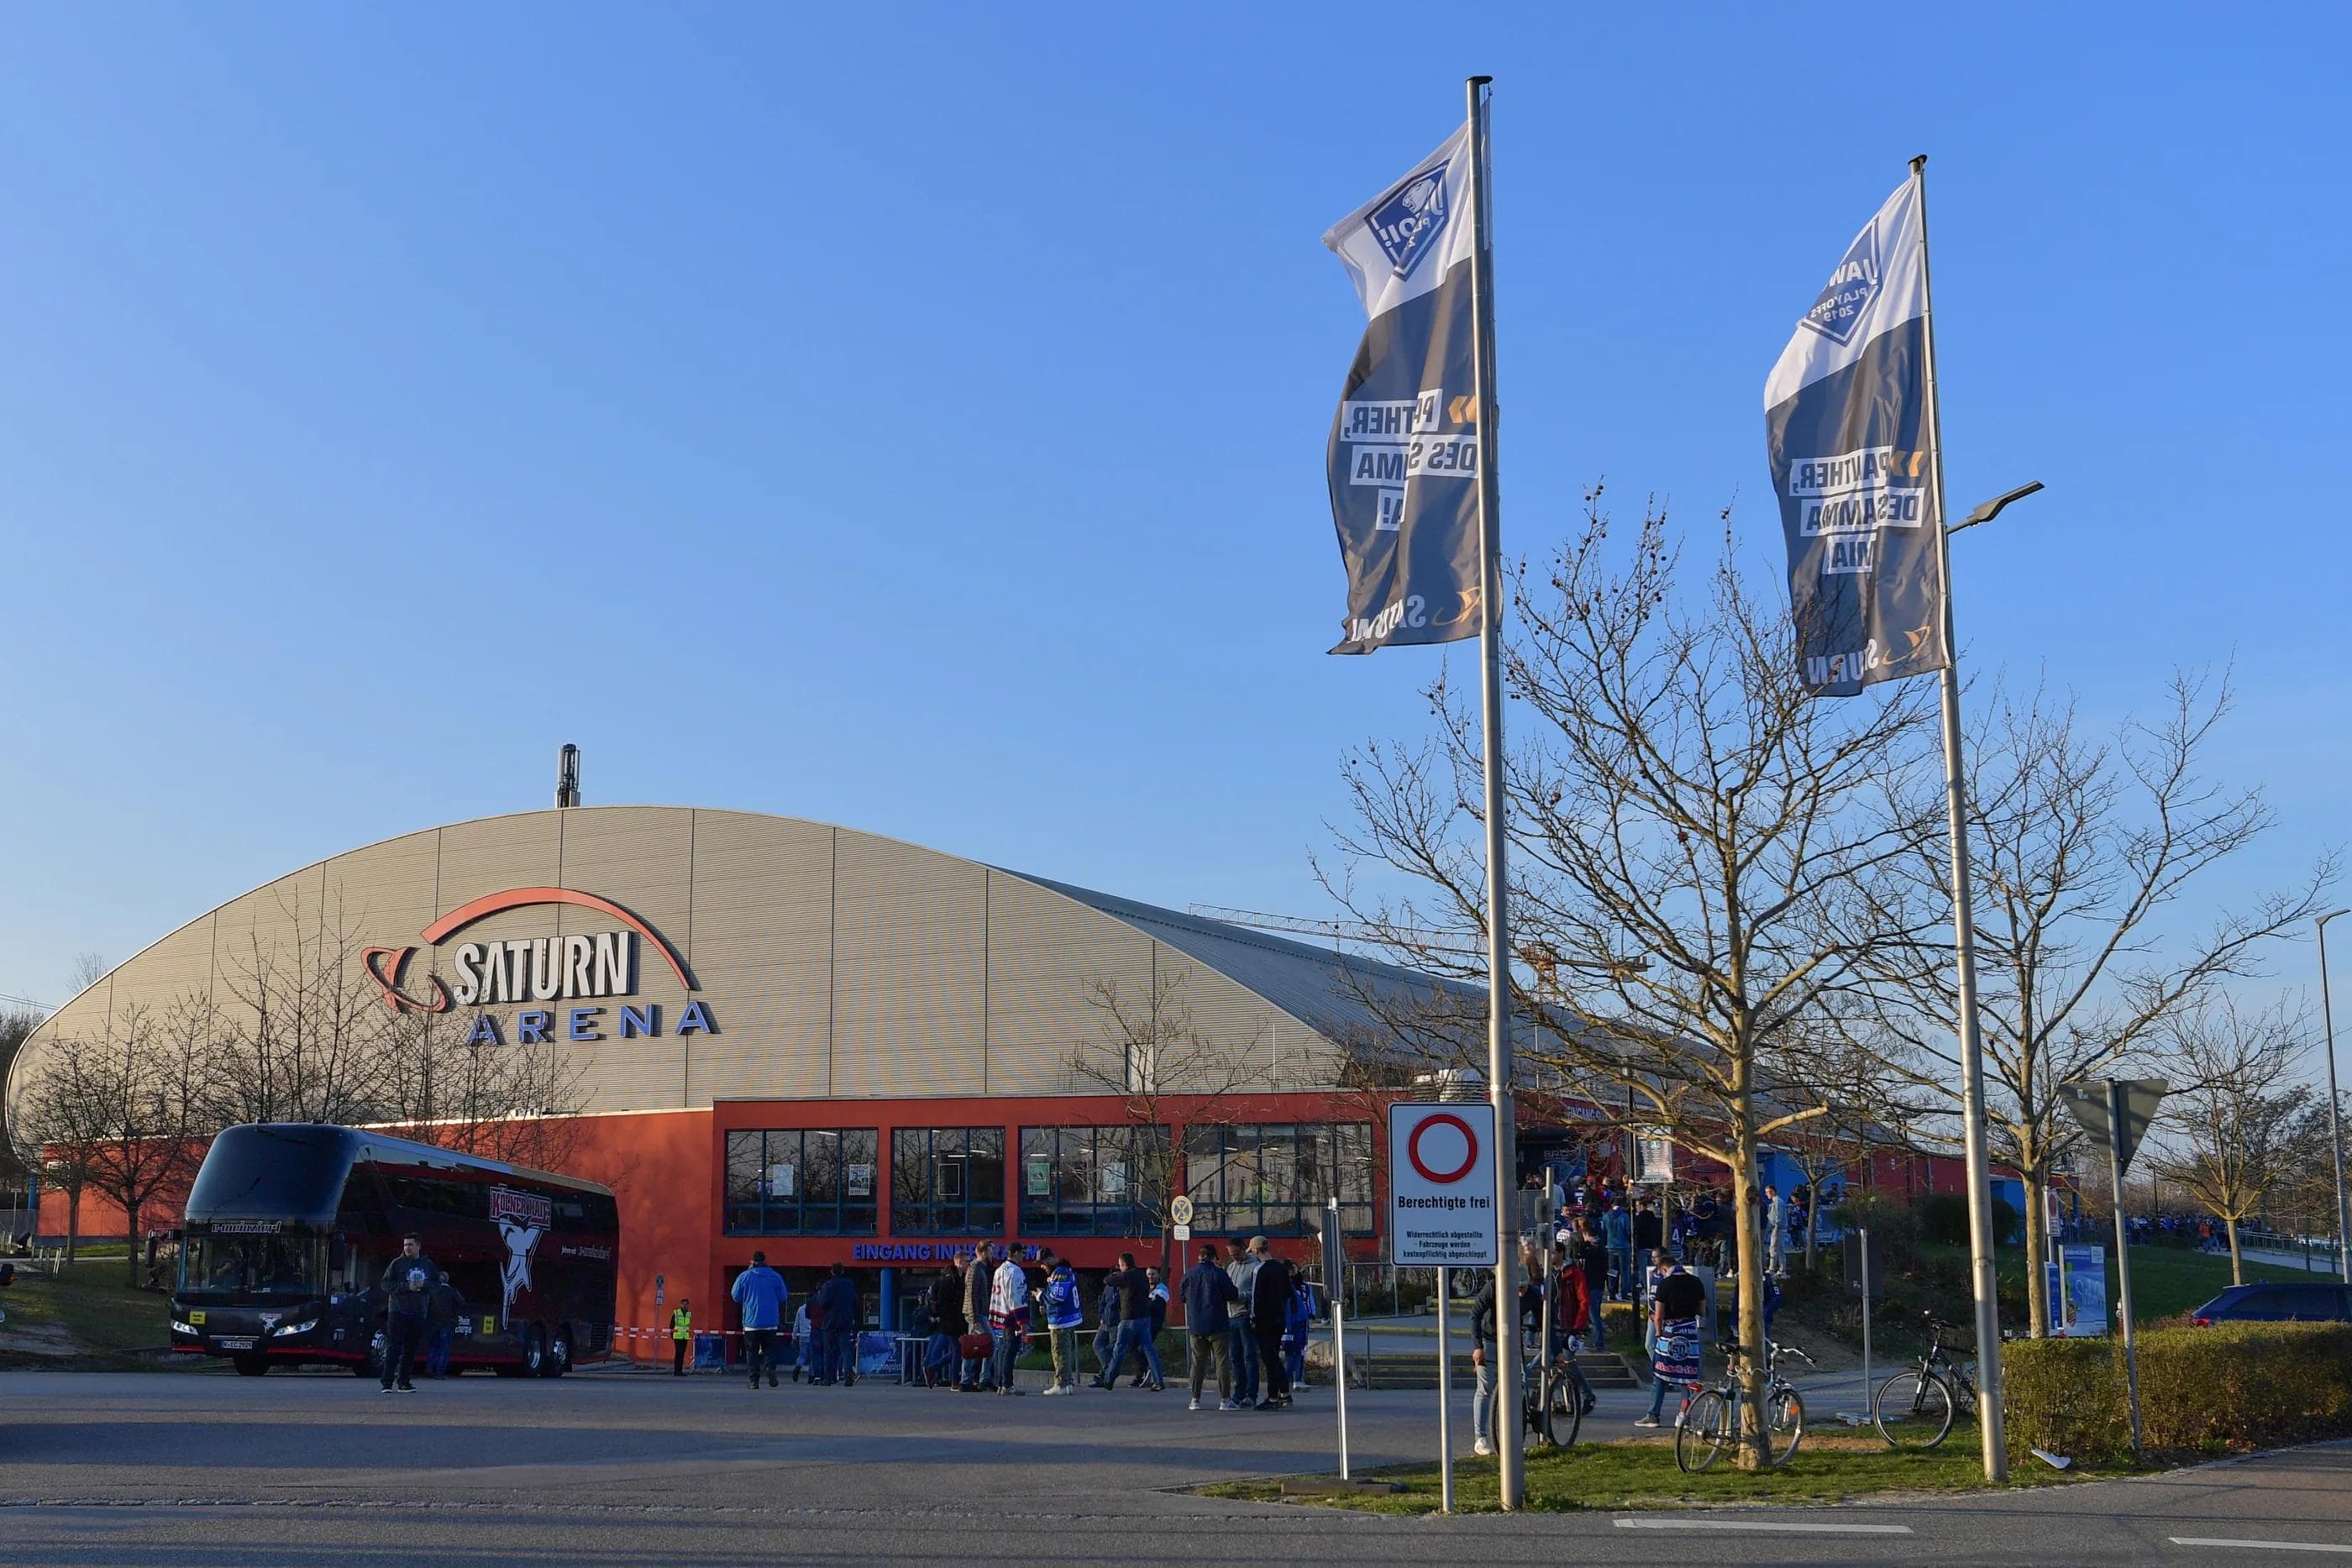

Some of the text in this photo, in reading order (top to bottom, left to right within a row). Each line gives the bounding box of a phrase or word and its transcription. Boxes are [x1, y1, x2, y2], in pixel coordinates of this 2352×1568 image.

[453, 930, 632, 1006] SATURN
[465, 1000, 711, 1046] ARENA
[1398, 1195, 1490, 1210] Berechtigte frei
[1406, 1230, 1483, 1240] Widerrechtlich abgestellte
[853, 1244, 931, 1260] EINGANG
[1419, 1240, 1471, 1250] Fahrzeuge werden
[1403, 1250, 1488, 1260] kostenpflichtig abgeschleppt
